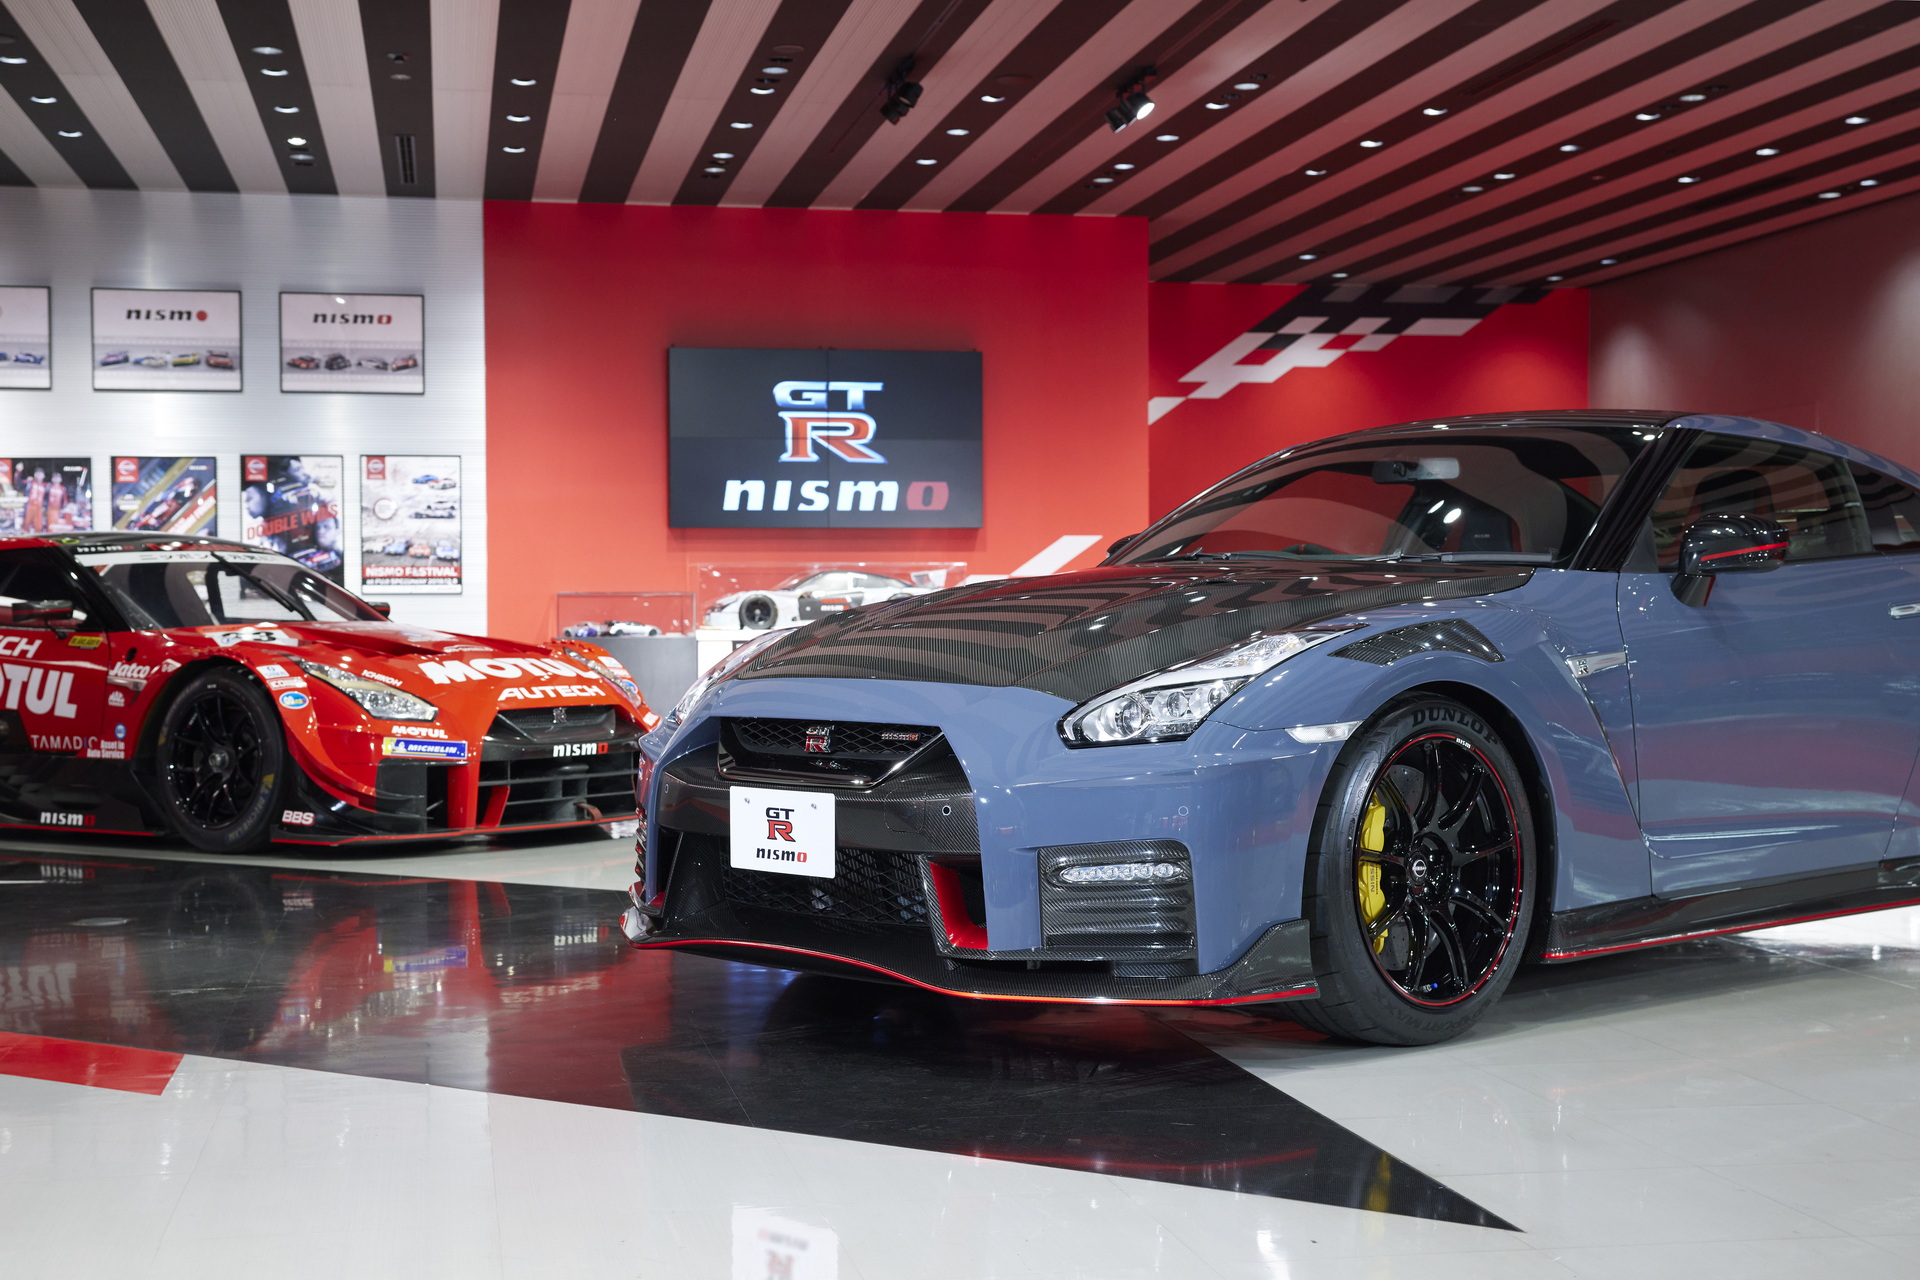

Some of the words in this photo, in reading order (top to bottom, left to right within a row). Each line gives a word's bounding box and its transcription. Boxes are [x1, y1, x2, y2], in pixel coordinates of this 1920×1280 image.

[313, 313, 392, 325] nismo
[773, 381, 884, 410] GT
[777, 411, 888, 464] R
[722, 480, 949, 511] nismo
[365, 566, 404, 577] NISMO
[0, 635, 43, 659] CH
[108, 662, 150, 679] Jatco
[361, 669, 403, 687] ICHIKOH
[418, 658, 600, 685] MOTUL
[0, 663, 78, 719] TUL
[497, 685, 606, 701] AUTECH
[391, 725, 448, 739] MOTUL
[1412, 706, 1500, 746] DUNLOP
[30, 735, 99, 750] TAMADIC
[407, 744, 457, 754] MICHELIN
[553, 742, 609, 758] nismo
[40, 812, 96, 827] nismo
[282, 810, 315, 825] BBS
[766, 807, 795, 820] GT
[767, 819, 796, 842] R
[756, 848, 807, 863] nismo
